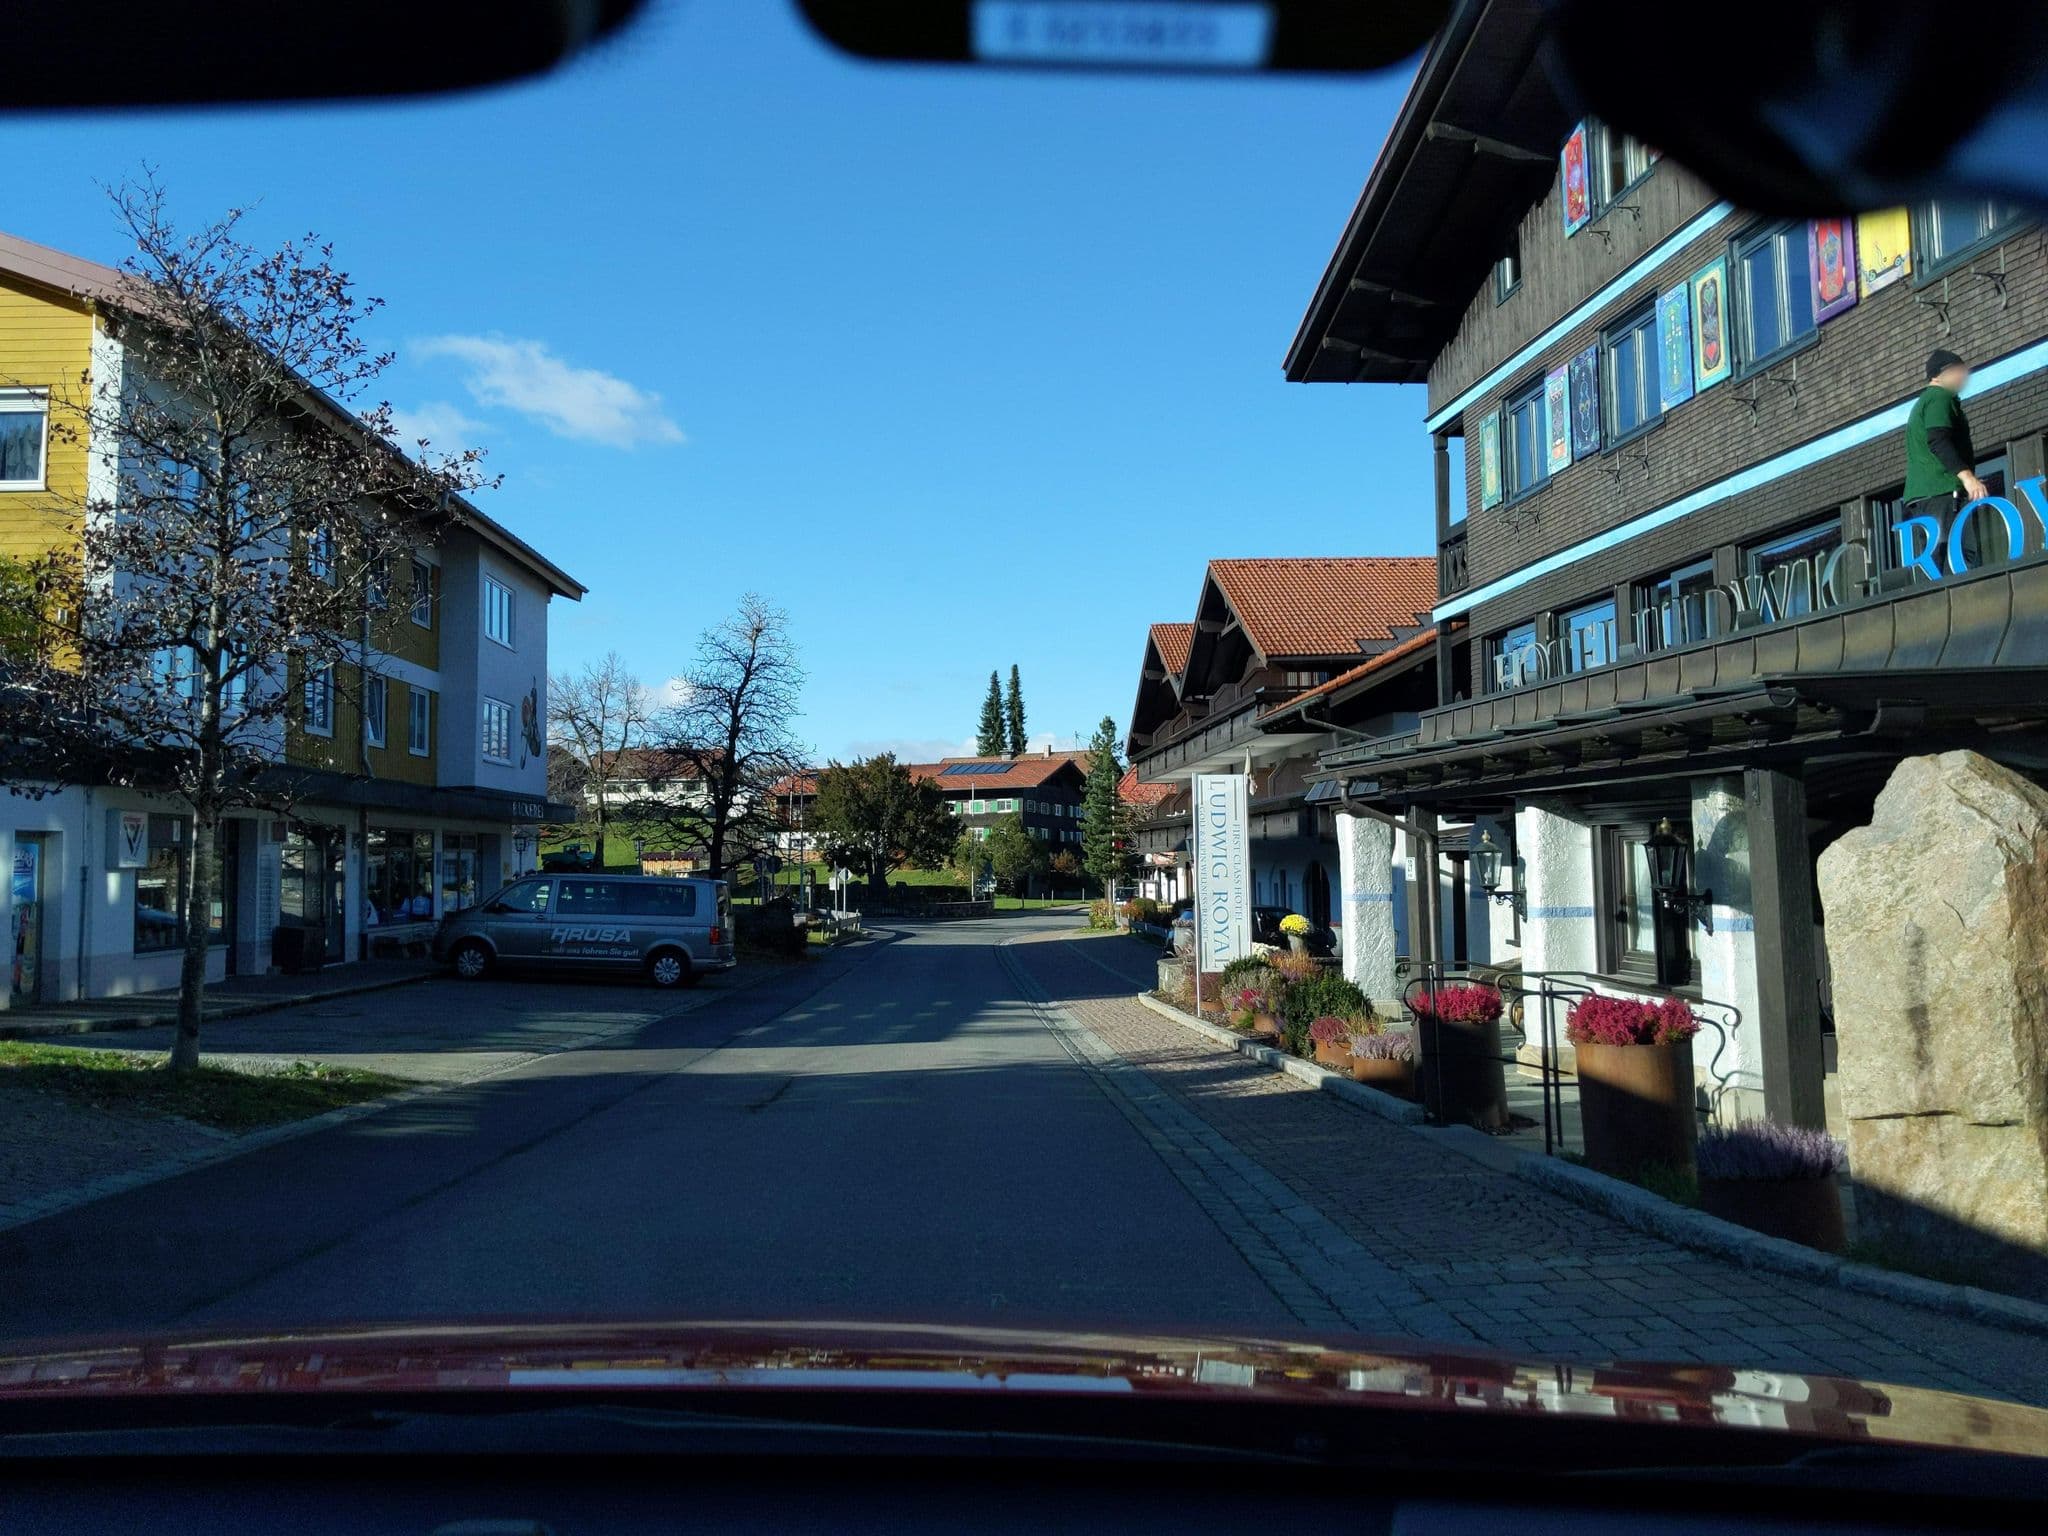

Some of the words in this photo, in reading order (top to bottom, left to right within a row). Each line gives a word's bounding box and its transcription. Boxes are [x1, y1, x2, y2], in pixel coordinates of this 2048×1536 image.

[1208, 780, 1228, 878] LUDWIG
[1232, 824, 1241, 852] FIRST
[1233, 854, 1242, 884] CLASS
[1234, 887, 1243, 922] HOTEL
[551, 928, 631, 943] HRUSA
[1212, 890, 1230, 968] ROYAL
